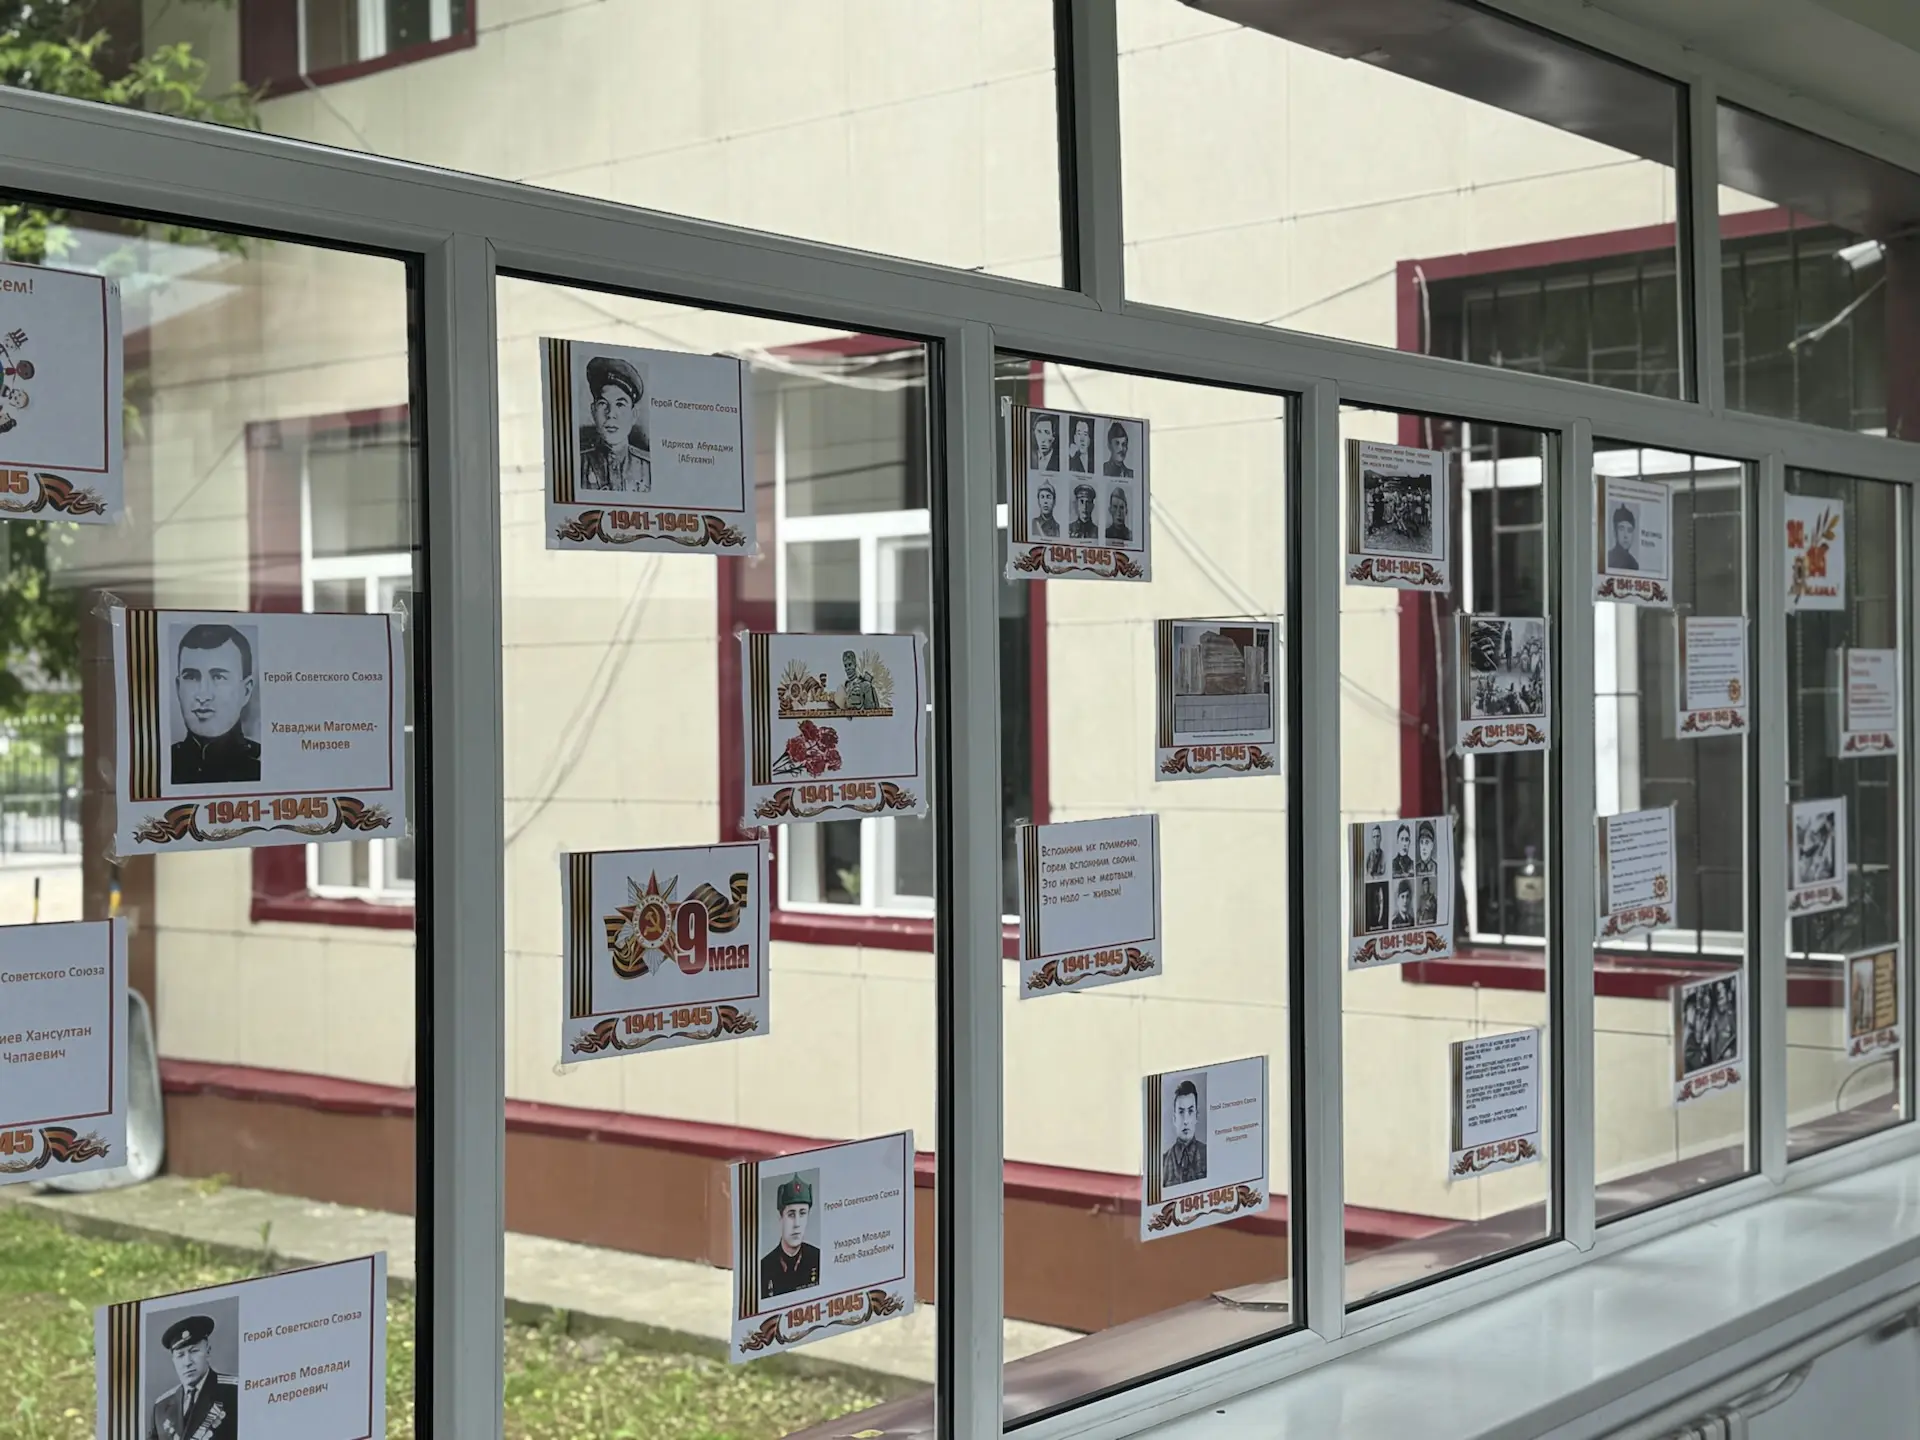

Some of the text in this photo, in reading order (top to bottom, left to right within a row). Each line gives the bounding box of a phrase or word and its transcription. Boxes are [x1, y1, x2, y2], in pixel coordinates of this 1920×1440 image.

[0, 279, 33, 294] ем!
[651, 398, 738, 414] Герой Советского Союза
[661, 439, 694, 450] Идрисов
[608, 510, 699, 532] 1941-1945
[1049, 545, 1112, 565] 1941-1945
[1375, 558, 1421, 575] 1941-1945
[264, 671, 383, 683] Герой Советского Союза
[271, 721, 378, 734] Хаваджи Магомед-
[1485, 723, 1525, 738] 1941-1945
[301, 739, 351, 751] Мирзоев
[1191, 746, 1246, 762] 1941-1945
[798, 782, 877, 803] 1941-1945
[204, 797, 329, 824] 1941-1945
[1086, 843, 1097, 852] их
[1042, 862, 1067, 874] Горем
[1070, 858, 1109, 870] вспомним
[1042, 878, 1057, 889] Это
[1060, 876, 1085, 888] нужно
[1087, 875, 1096, 884] не
[1042, 895, 1057, 905] Это
[1060, 893, 1080, 903] надо
[1093, 884, 1122, 899] живым!
[675, 900, 709, 975] 9
[708, 944, 750, 972] мая
[1378, 931, 1425, 950] 1941-1945
[1062, 949, 1124, 973] 1941-1945
[1, 966, 105, 983] Советского Союза
[622, 1006, 713, 1035] 1941-1945
[26, 1026, 92, 1042] Хансултан
[3, 1049, 66, 1063] Чапаевич
[1476, 1140, 1518, 1161] 1941-1945
[824, 1189, 900, 1211] Герой Советского Союза
[1179, 1187, 1235, 1214] 1941-1945
[785, 1293, 865, 1329] 1941-1945
[243, 1310, 362, 1342] Герой Советского Союза
[299, 1359, 351, 1379] Мовлади
[267, 1382, 329, 1404] Алероевич
